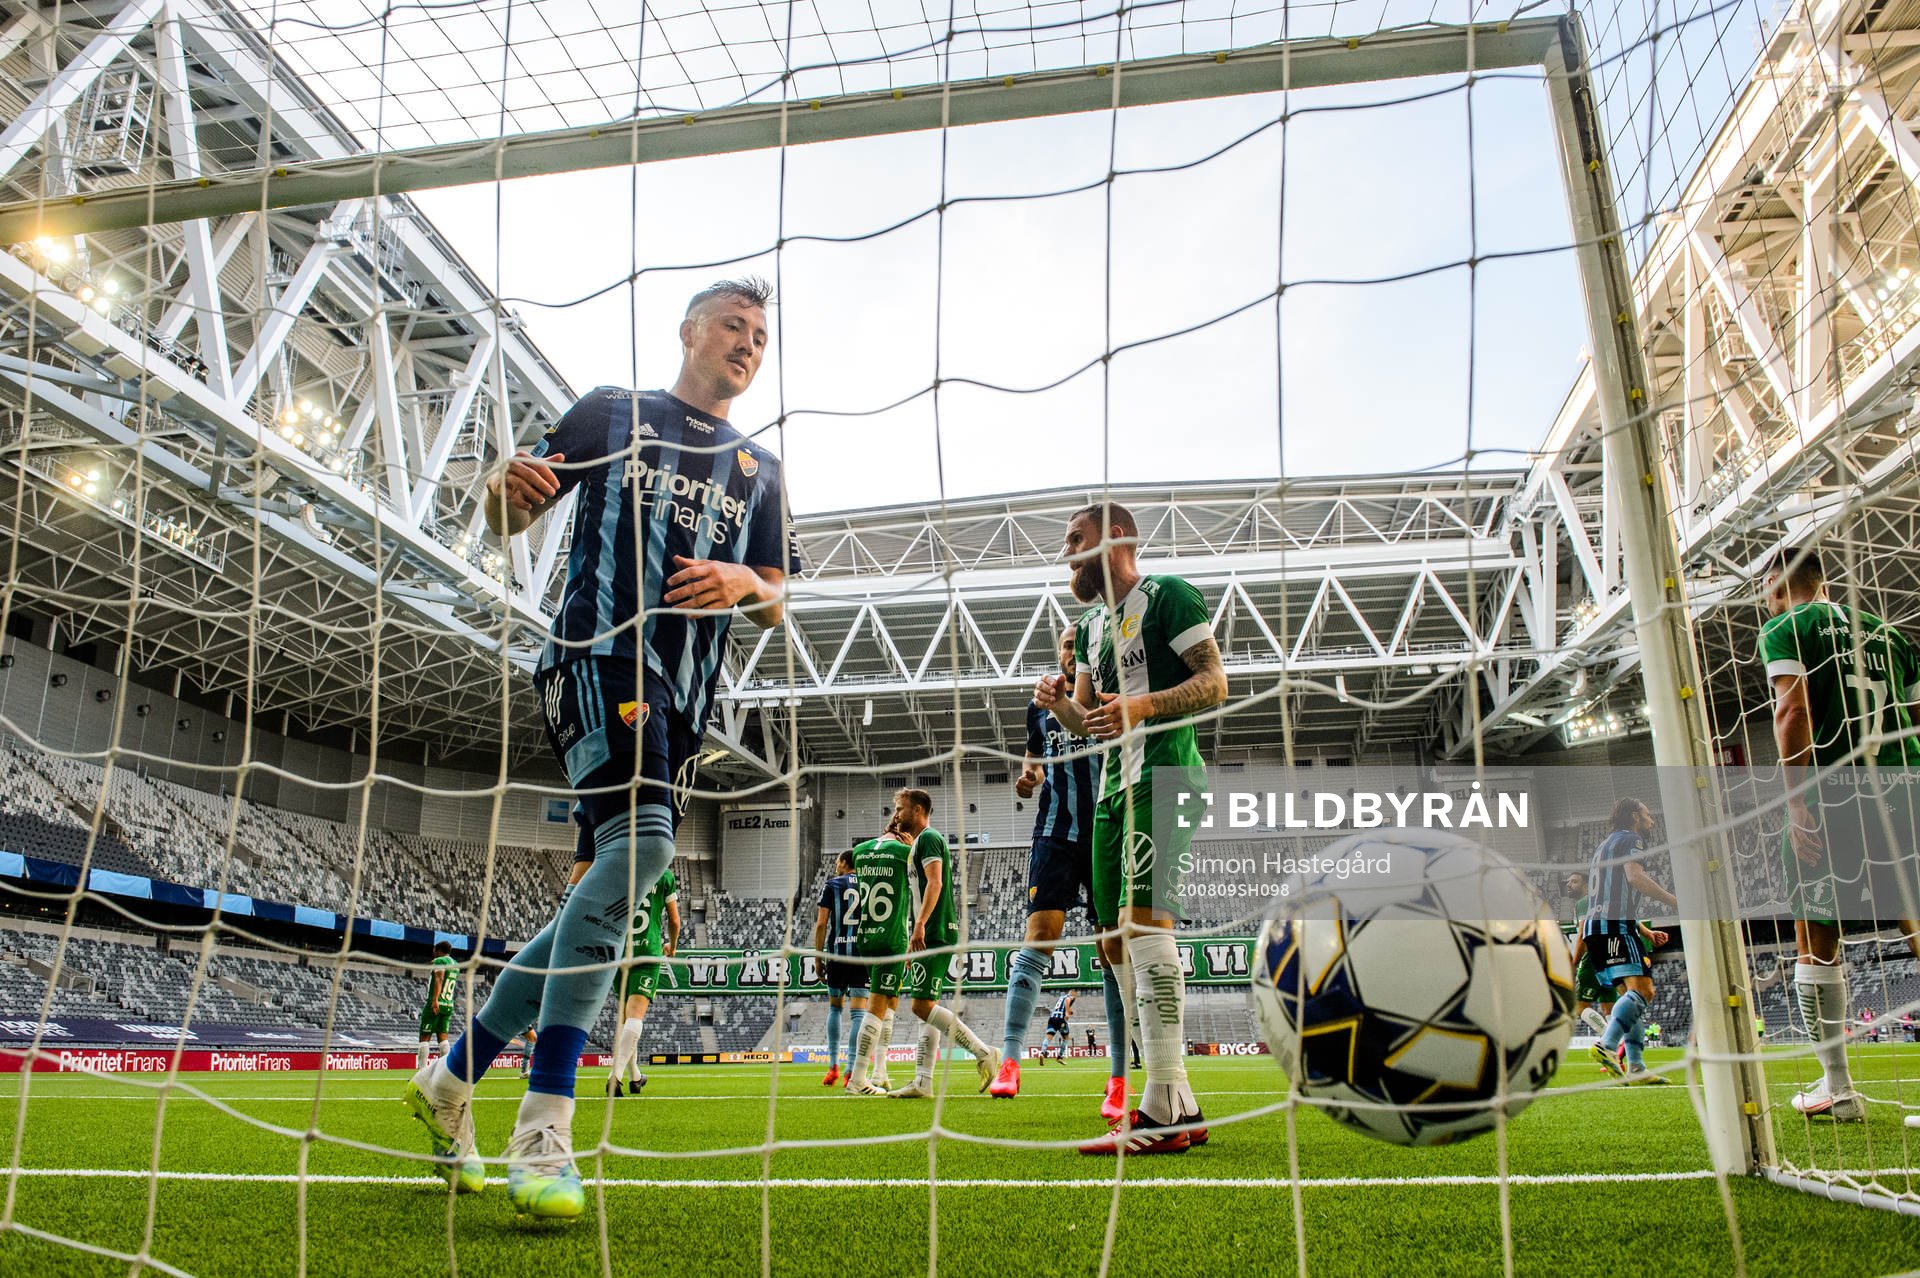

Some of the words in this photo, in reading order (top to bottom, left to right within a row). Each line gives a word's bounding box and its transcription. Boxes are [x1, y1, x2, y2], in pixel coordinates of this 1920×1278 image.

[630, 430, 658, 438] aidas
[622, 460, 746, 528] Prioritet
[640, 490, 728, 544] Finans
[1845, 674, 1888, 756] 7
[728, 816, 761, 830] TELE2
[763, 818, 794, 829] Aren
[857, 865, 894, 877] BJÖRKLUND
[860, 882, 895, 922] 26
[583, 914, 602, 926] NRC
[602, 921, 623, 937] Group
[687, 956, 728, 987] VI
[737, 949, 791, 987] ÄR
[1203, 944, 1249, 977] VI
[441, 978, 457, 1001] 19
[1147, 963, 1181, 1026] Clinton
[1219, 1043, 1260, 1055] BYGG
[59, 1051, 122, 1072] Prioritet
[124, 1052, 166, 1072] Finans
[210, 1052, 257, 1071] Prioritet
[258, 1053, 290, 1071] Finans
[326, 1053, 363, 1070] Prioritet
[363, 1054, 388, 1070] Finans
